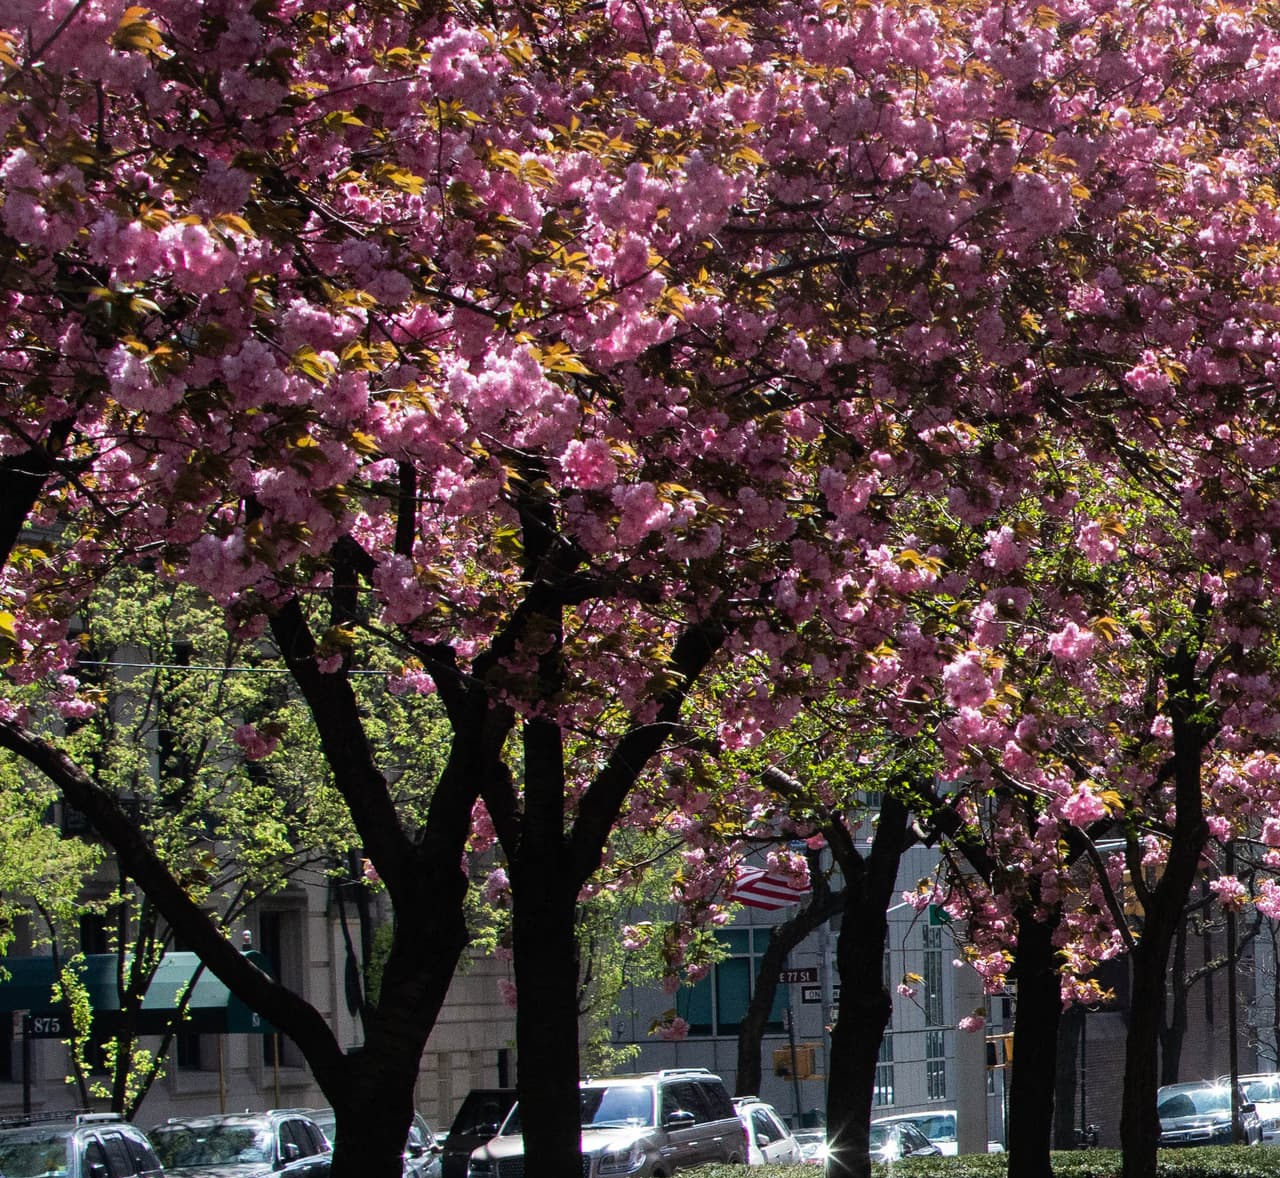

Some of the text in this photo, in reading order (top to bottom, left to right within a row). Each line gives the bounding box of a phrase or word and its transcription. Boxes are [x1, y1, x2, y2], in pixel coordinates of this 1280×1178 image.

[787, 972, 798, 981] 77
[800, 971, 810, 981] St
[34, 1017, 61, 1033] 875
